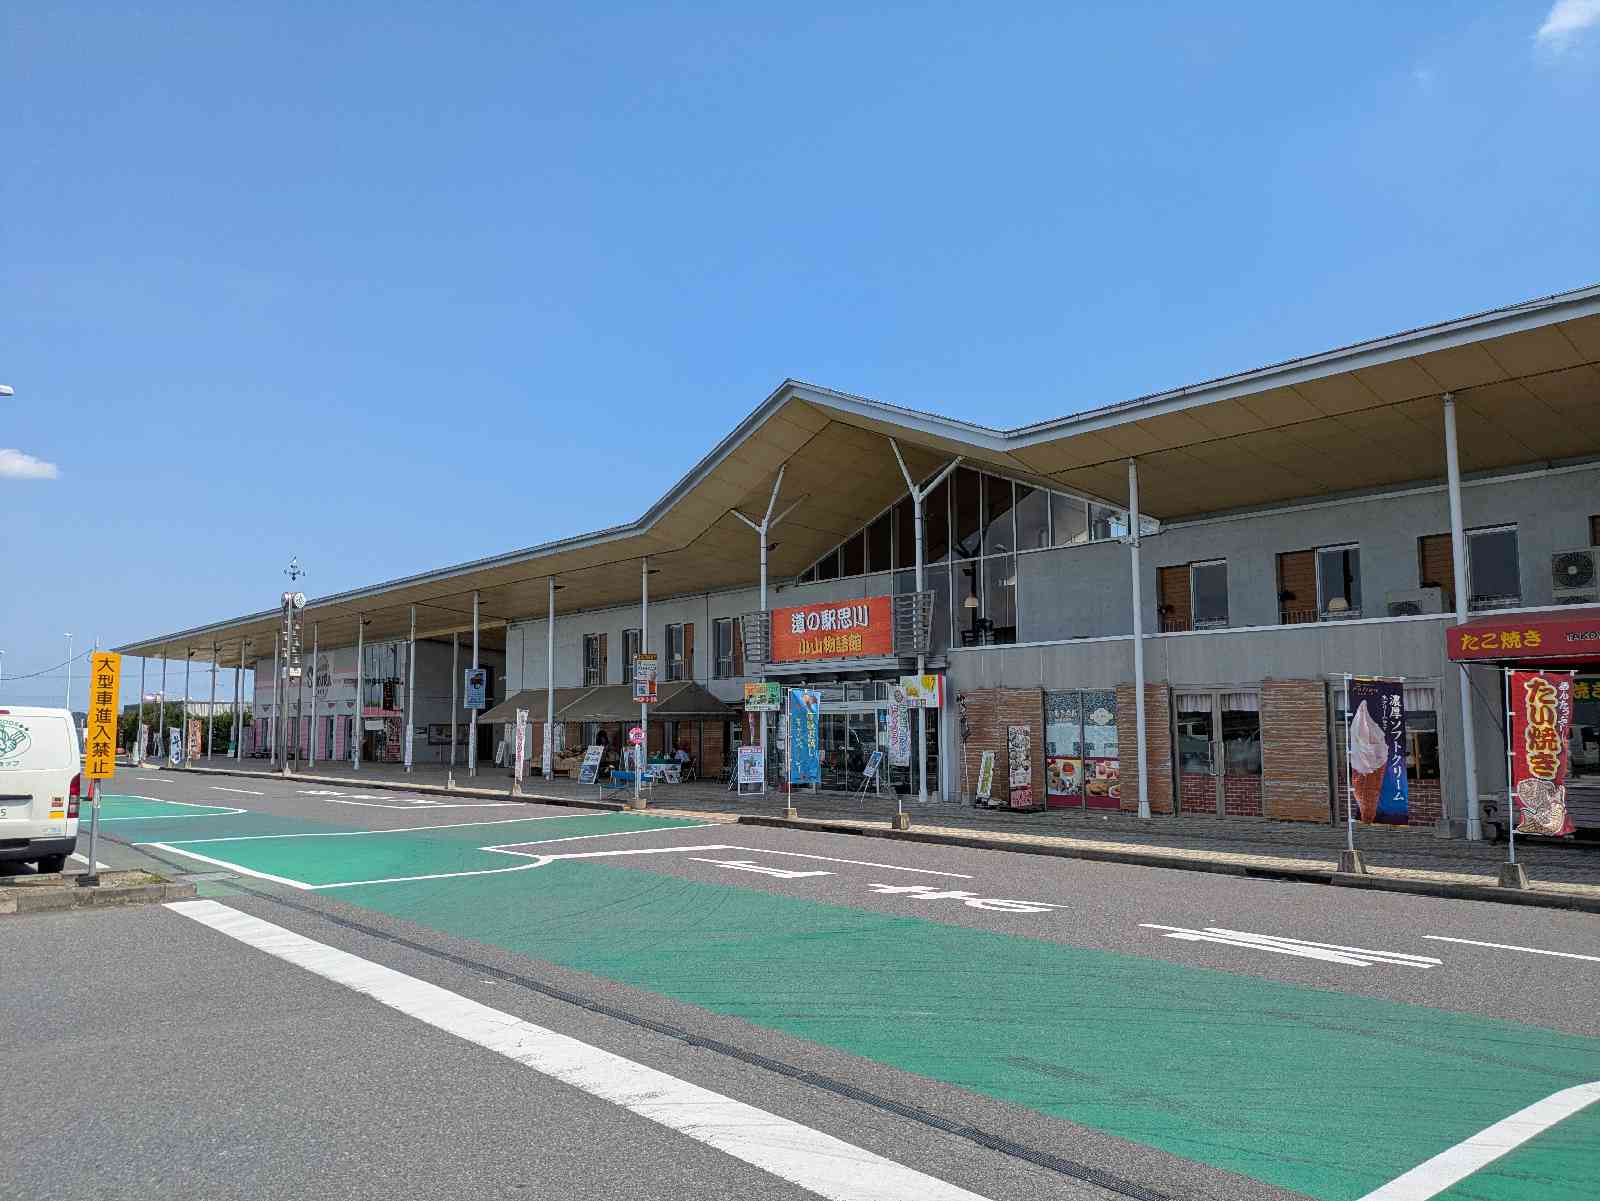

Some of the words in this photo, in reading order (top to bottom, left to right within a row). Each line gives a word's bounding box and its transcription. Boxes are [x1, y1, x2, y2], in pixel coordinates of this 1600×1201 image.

[791, 604, 870, 634] 道の駅思川
[799, 632, 864, 656] 小山物語館
[1460, 628, 1542, 651] たこ焼き
[91, 656, 117, 775] 大型車進入禁止
[1388, 693, 1406, 802] 濃厚ソフトクリーム
[1525, 678, 1561, 779] たい焼き
